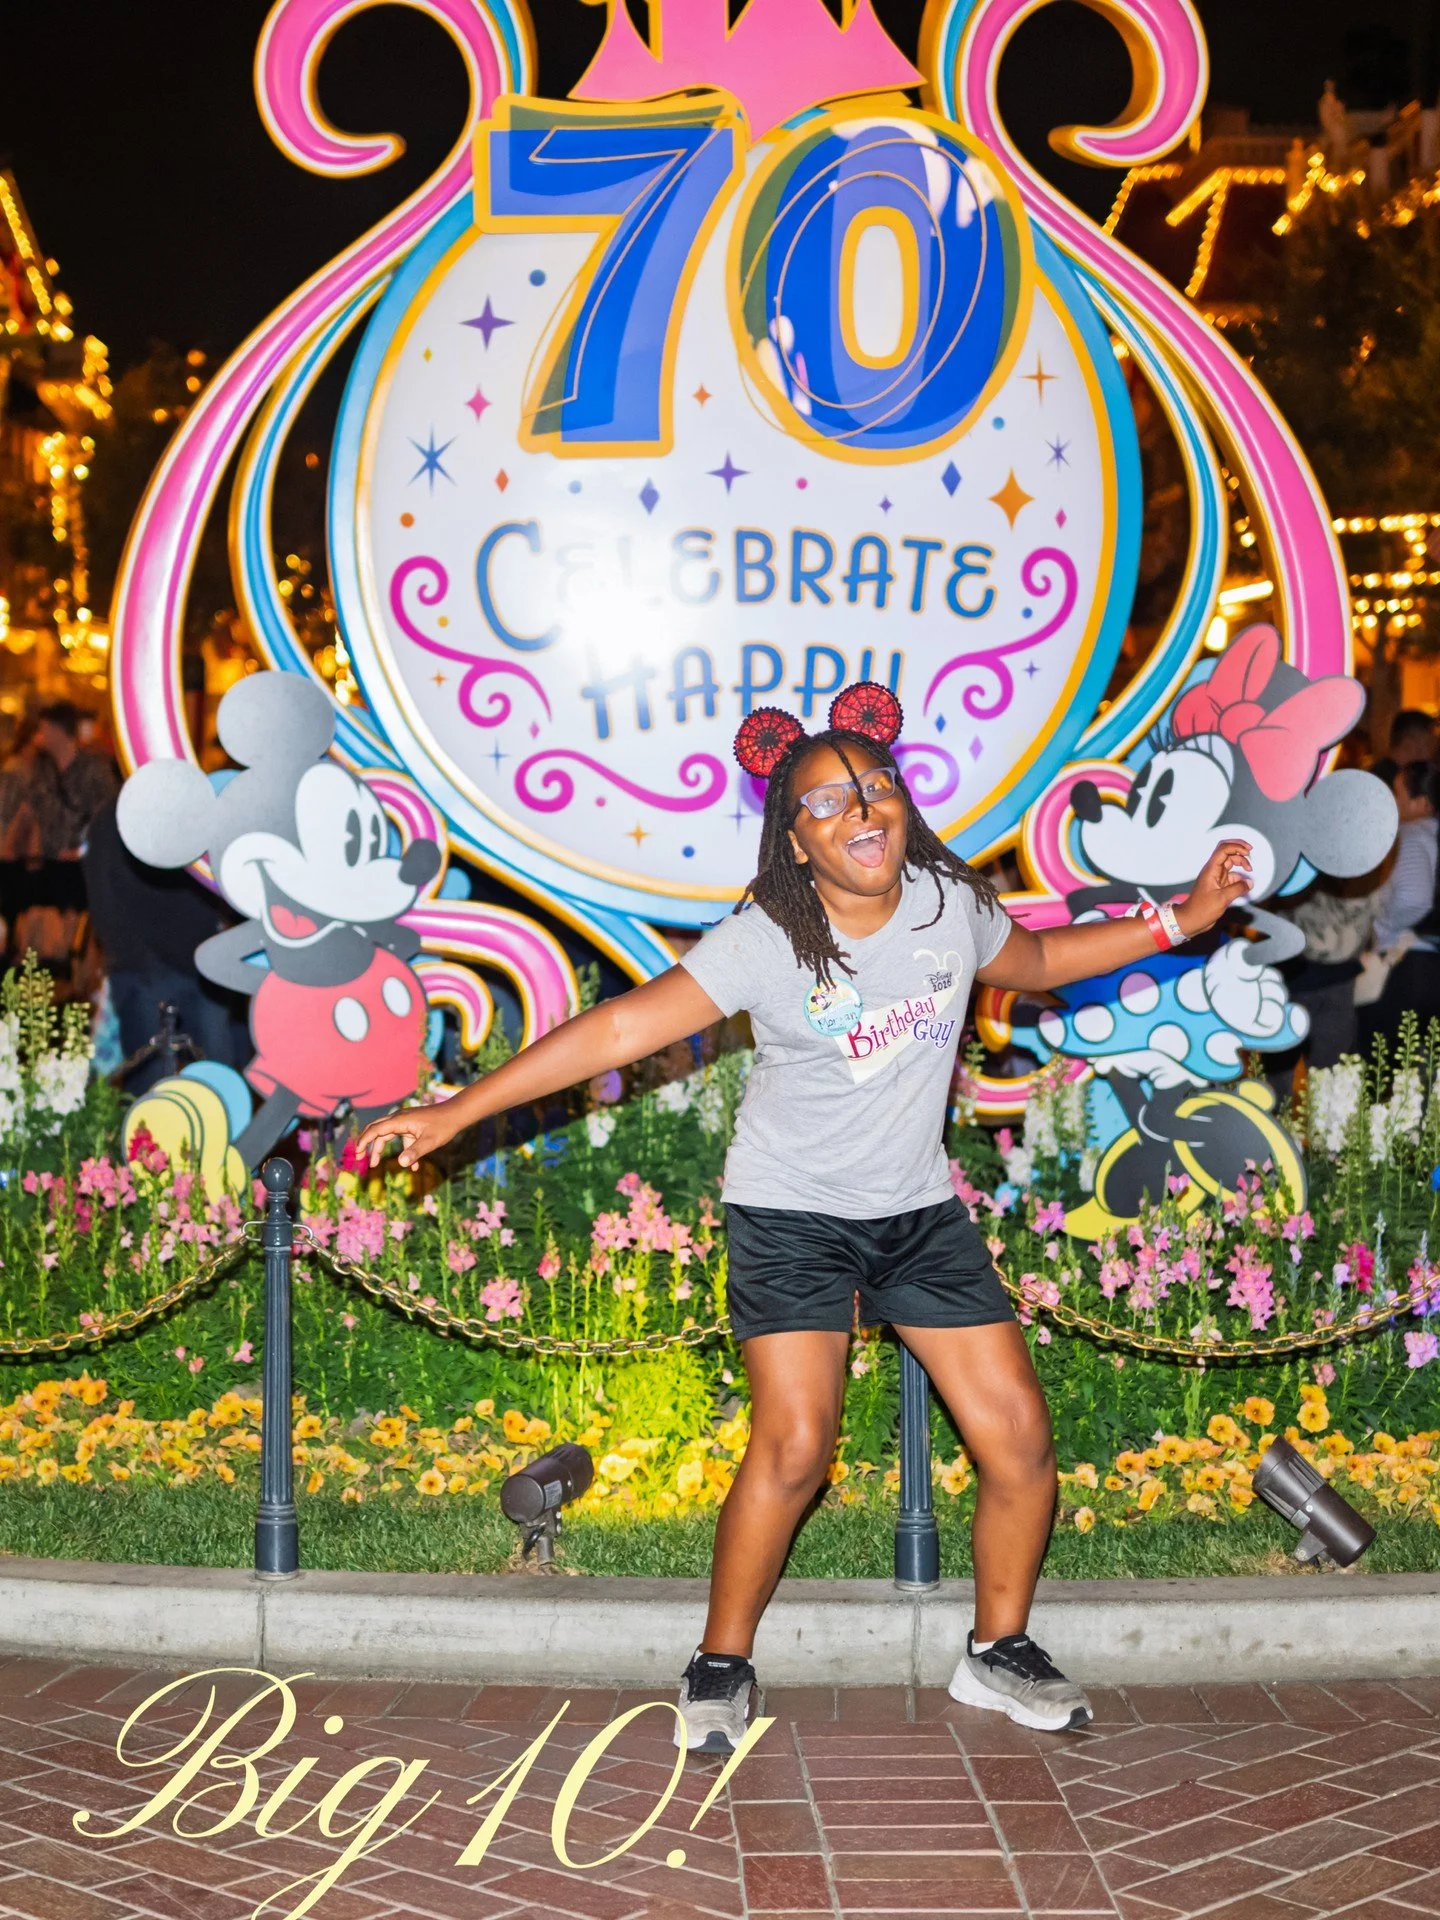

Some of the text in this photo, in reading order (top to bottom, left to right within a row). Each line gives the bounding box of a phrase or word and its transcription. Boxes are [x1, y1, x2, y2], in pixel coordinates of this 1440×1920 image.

[473, 95, 1035, 466] 70
[932, 978, 952, 993] 2026
[845, 996, 936, 1060] Birthday
